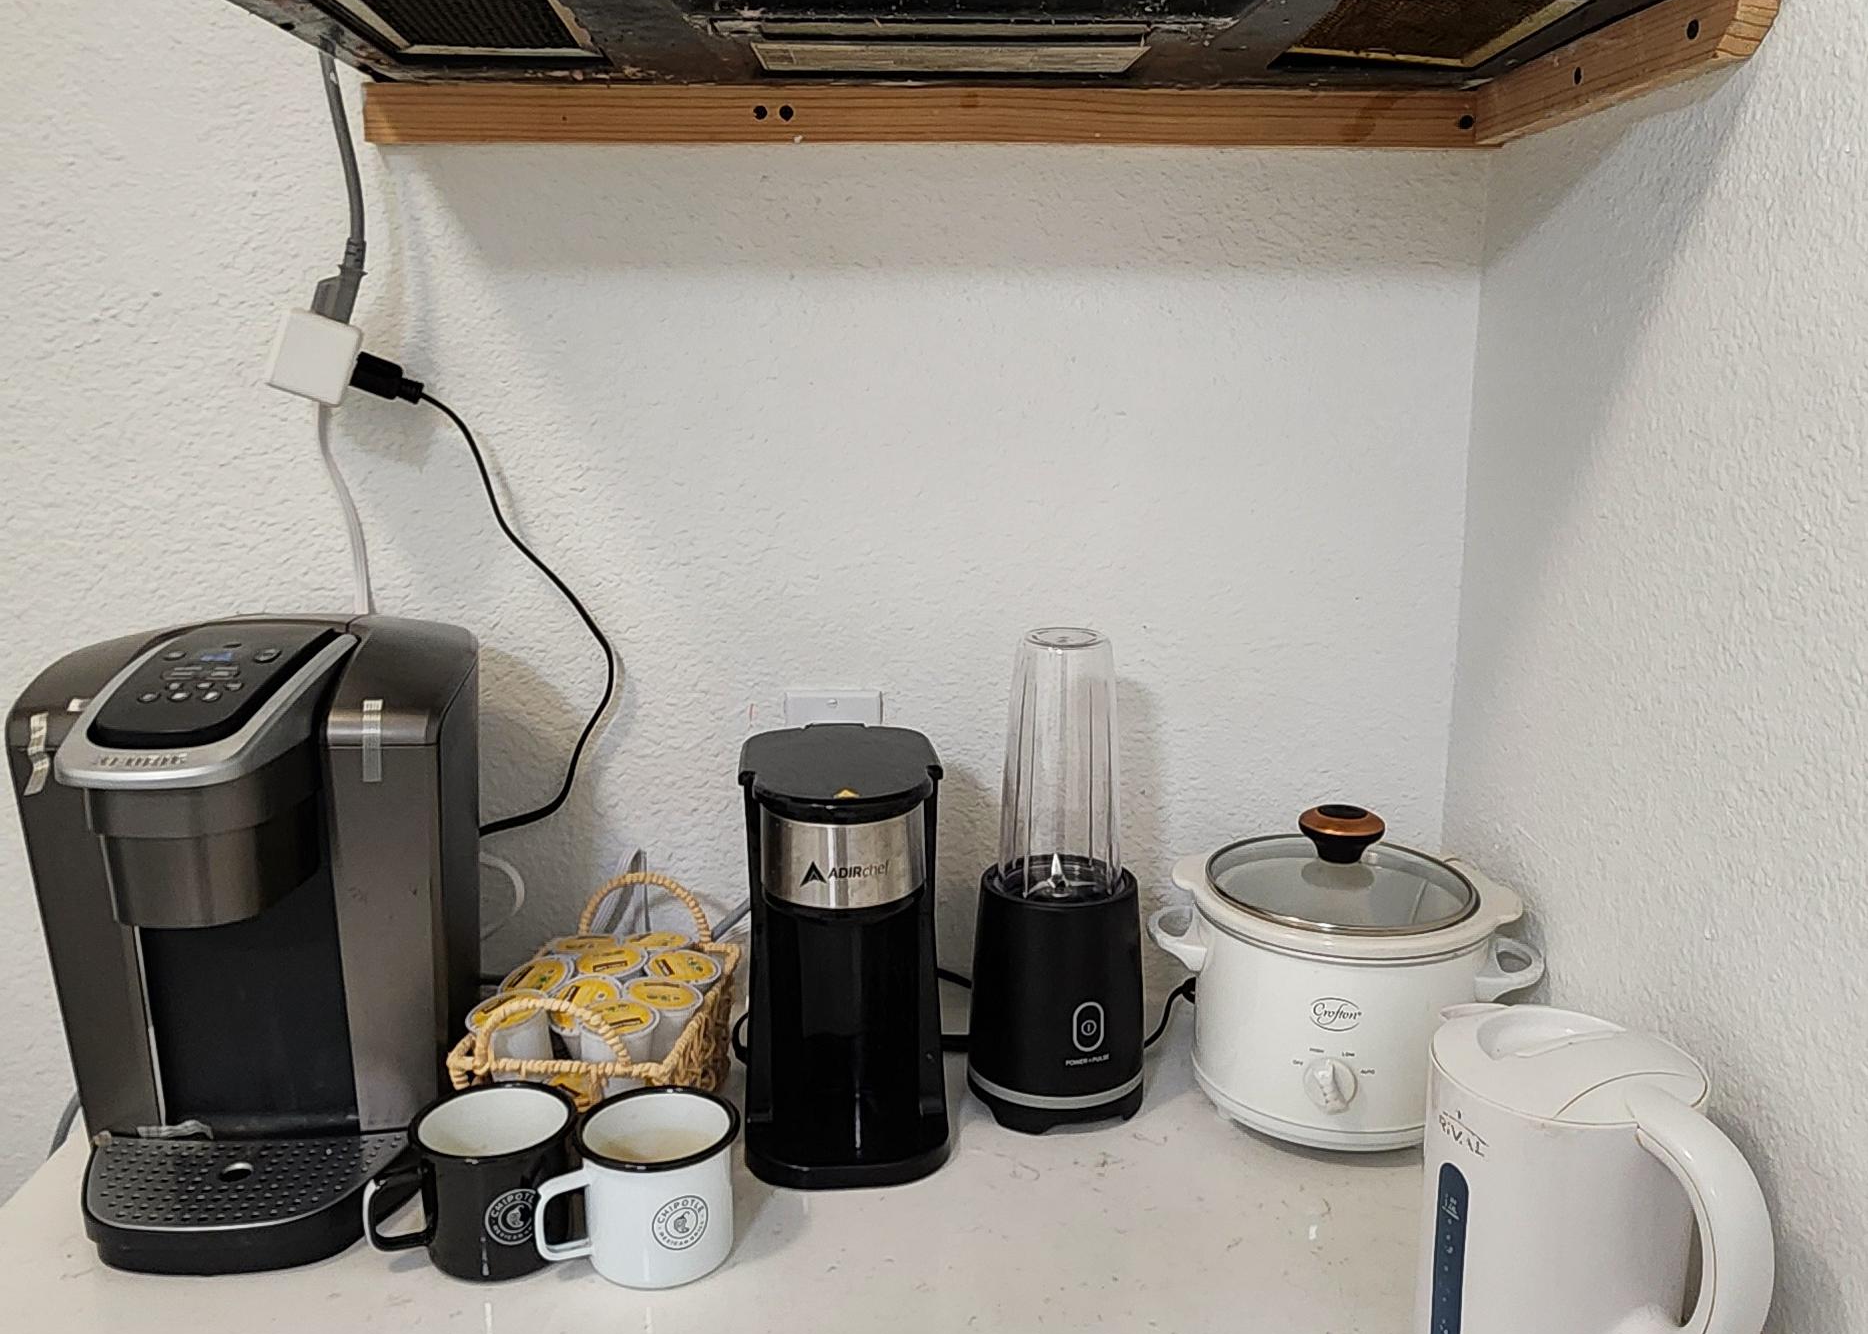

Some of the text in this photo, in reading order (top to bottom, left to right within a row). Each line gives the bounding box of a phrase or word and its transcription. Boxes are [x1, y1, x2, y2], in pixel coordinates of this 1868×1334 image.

[1312, 1002, 1358, 1026] Crofton
[490, 1191, 535, 1218] CHIPOTL
[656, 1198, 705, 1224] CHIPOTLE
